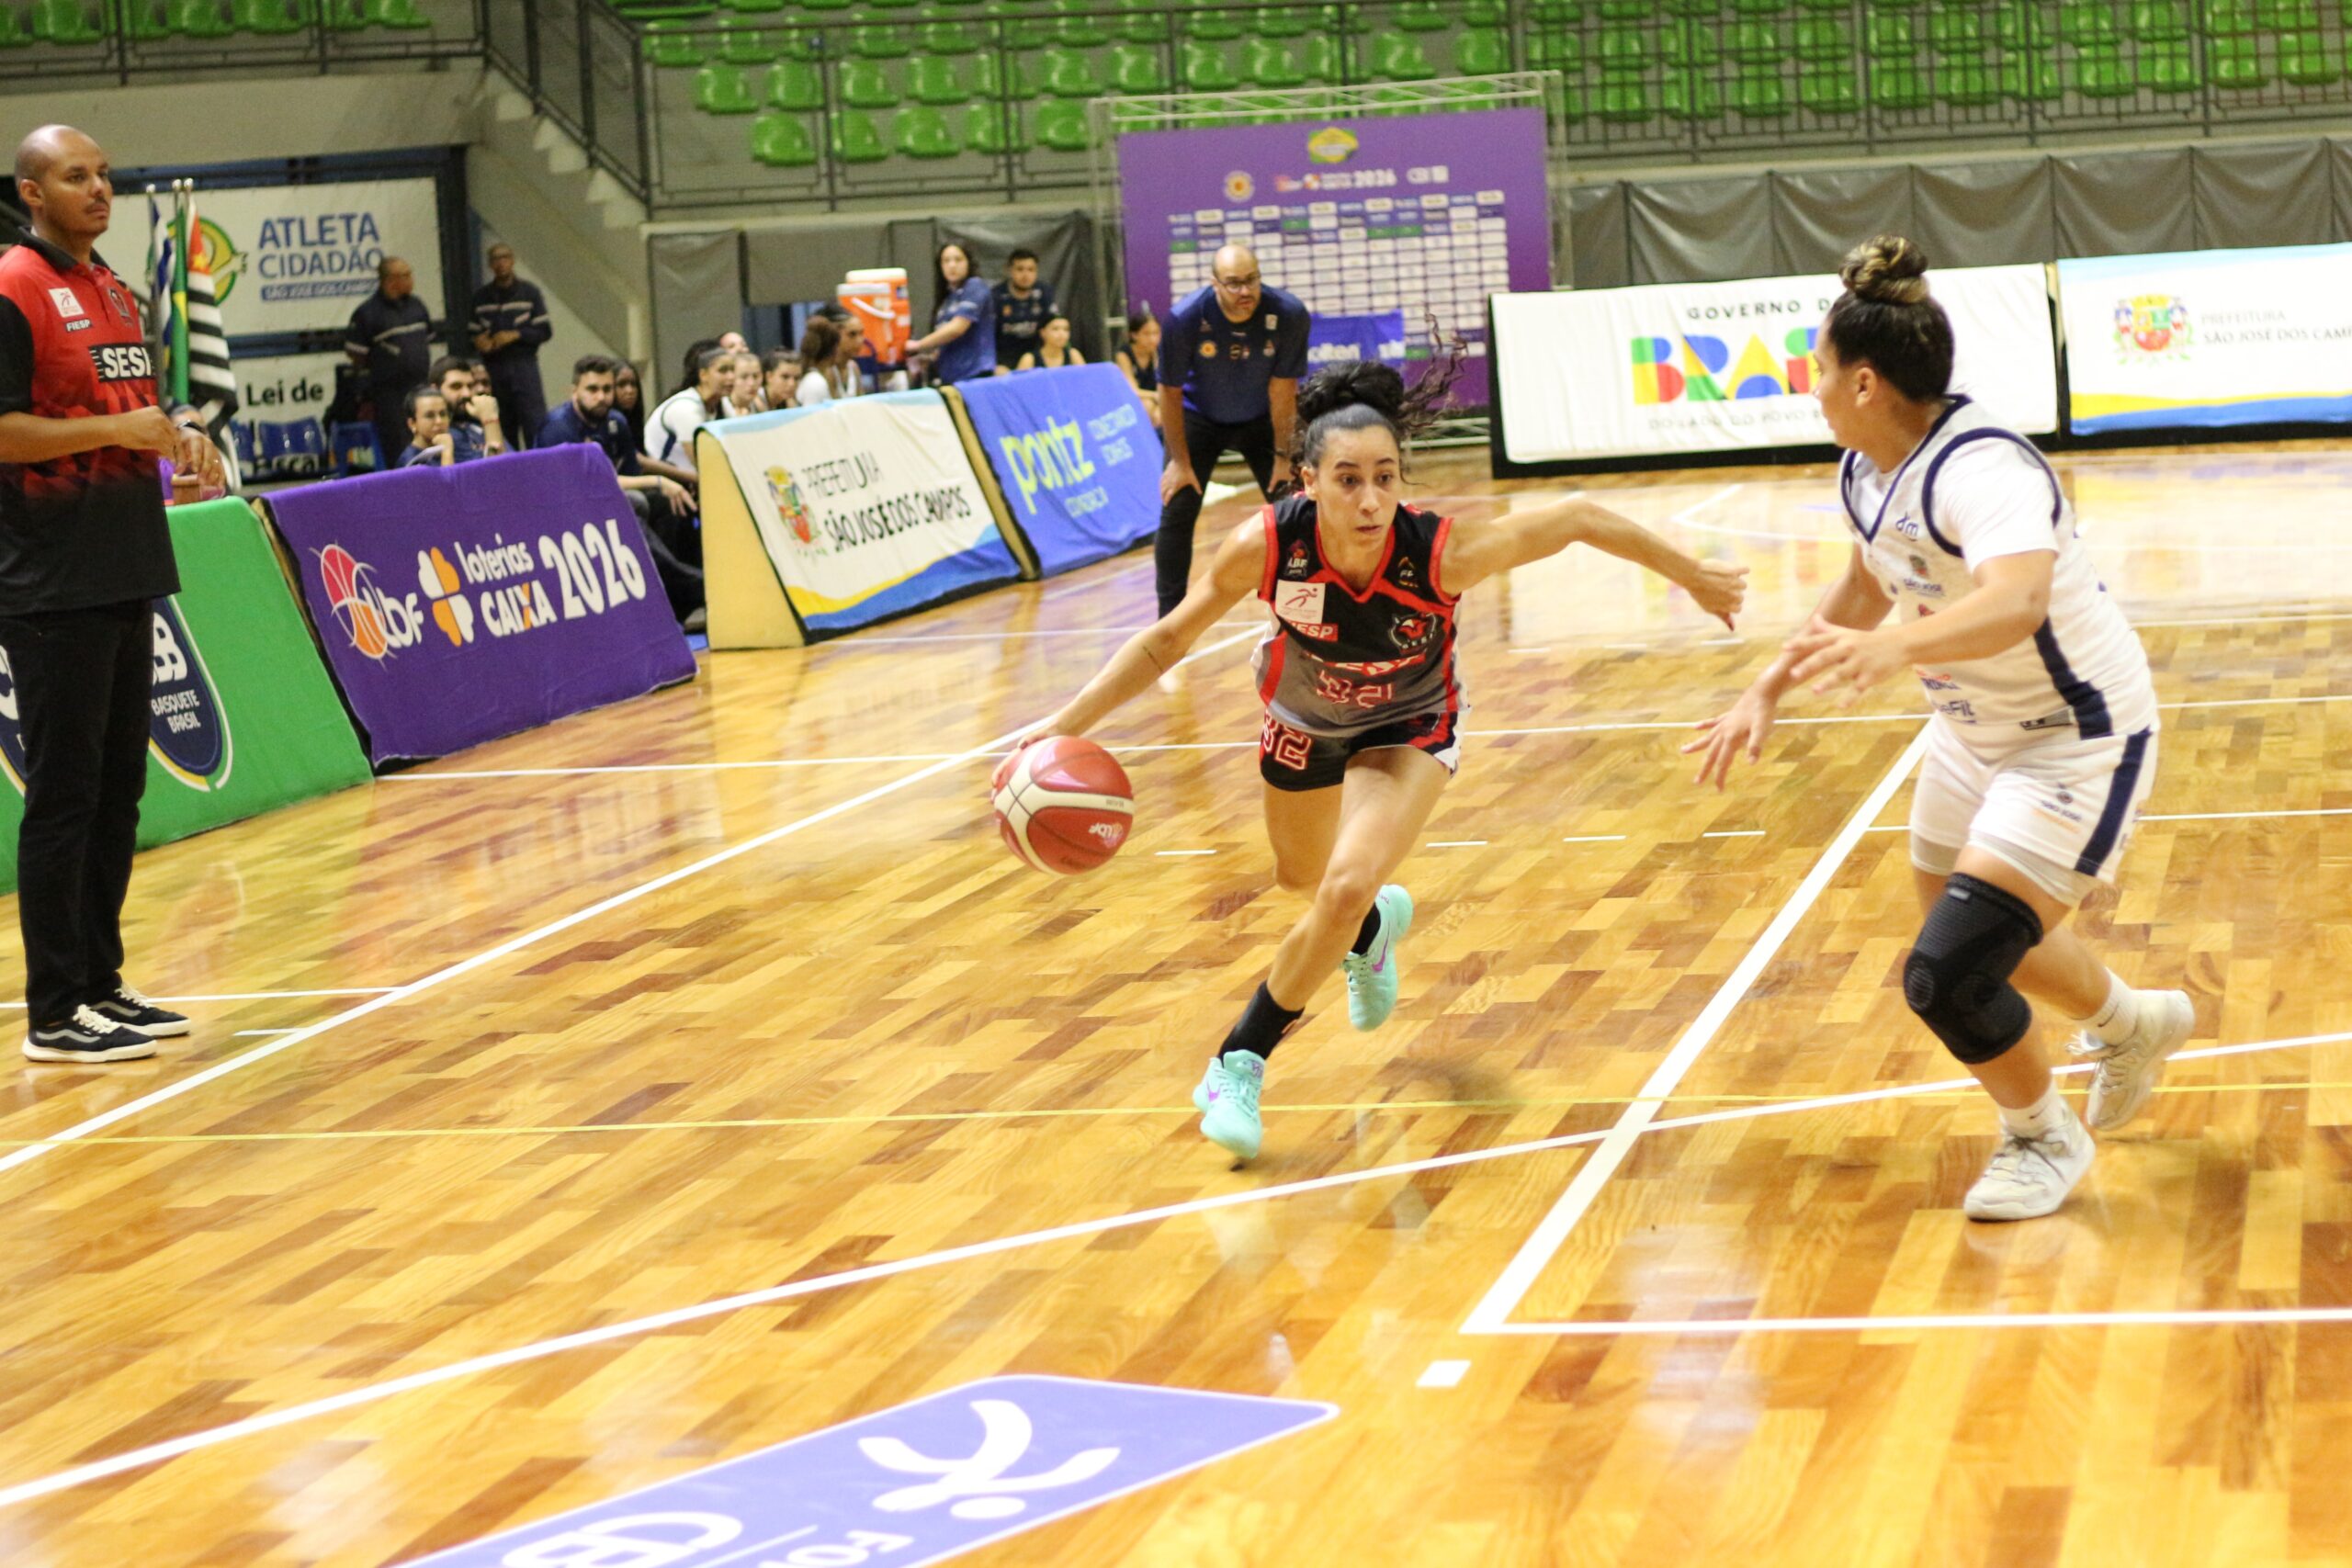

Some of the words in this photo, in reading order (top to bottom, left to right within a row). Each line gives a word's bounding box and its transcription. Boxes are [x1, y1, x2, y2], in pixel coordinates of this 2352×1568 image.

[258, 212, 380, 250] ATLETA
[258, 244, 385, 279] CIDADÃO
[66, 319, 91, 333] FIESP
[1687, 299, 1802, 320] GOVERNO
[102, 346, 152, 378] SESI
[246, 379, 285, 407] Lei
[291, 378, 324, 403] de
[999, 415, 1096, 515] pontz
[823, 508, 857, 553] SÃO
[854, 494, 895, 545] JOSÉ
[886, 493, 920, 533] DOS
[914, 485, 972, 524] CAMPOS
[454, 532, 535, 585] loterias
[538, 518, 647, 620] 2026
[481, 580, 558, 637] CAIXA
[151, 689, 201, 717] BASQUETE
[167, 710, 202, 734] BRASIL
